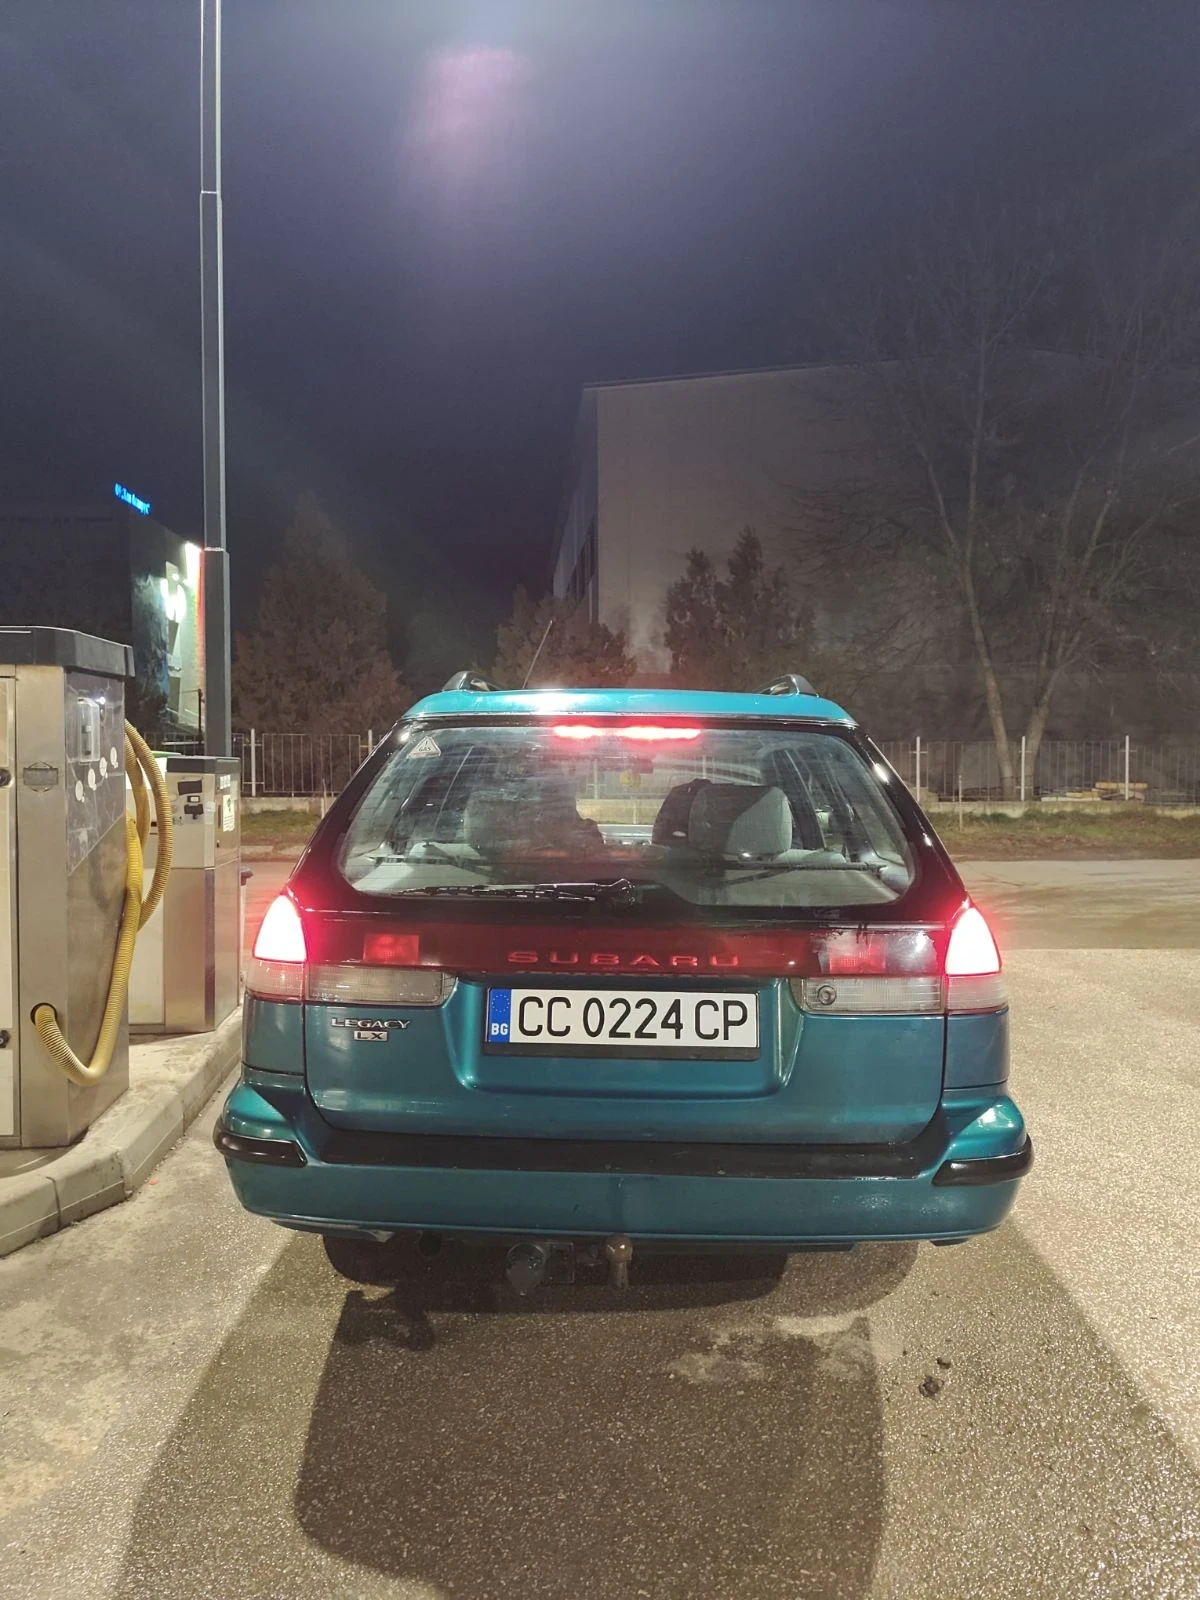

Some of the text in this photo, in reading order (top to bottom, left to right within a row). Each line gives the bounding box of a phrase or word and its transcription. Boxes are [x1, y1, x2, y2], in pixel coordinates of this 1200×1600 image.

[507, 951, 738, 966] SUBARU
[331, 1018, 410, 1029] LEGACY
[518, 996, 748, 1041] CC 0224 CP
[356, 1032, 384, 1040] LX
[491, 1023, 508, 1036] BG
